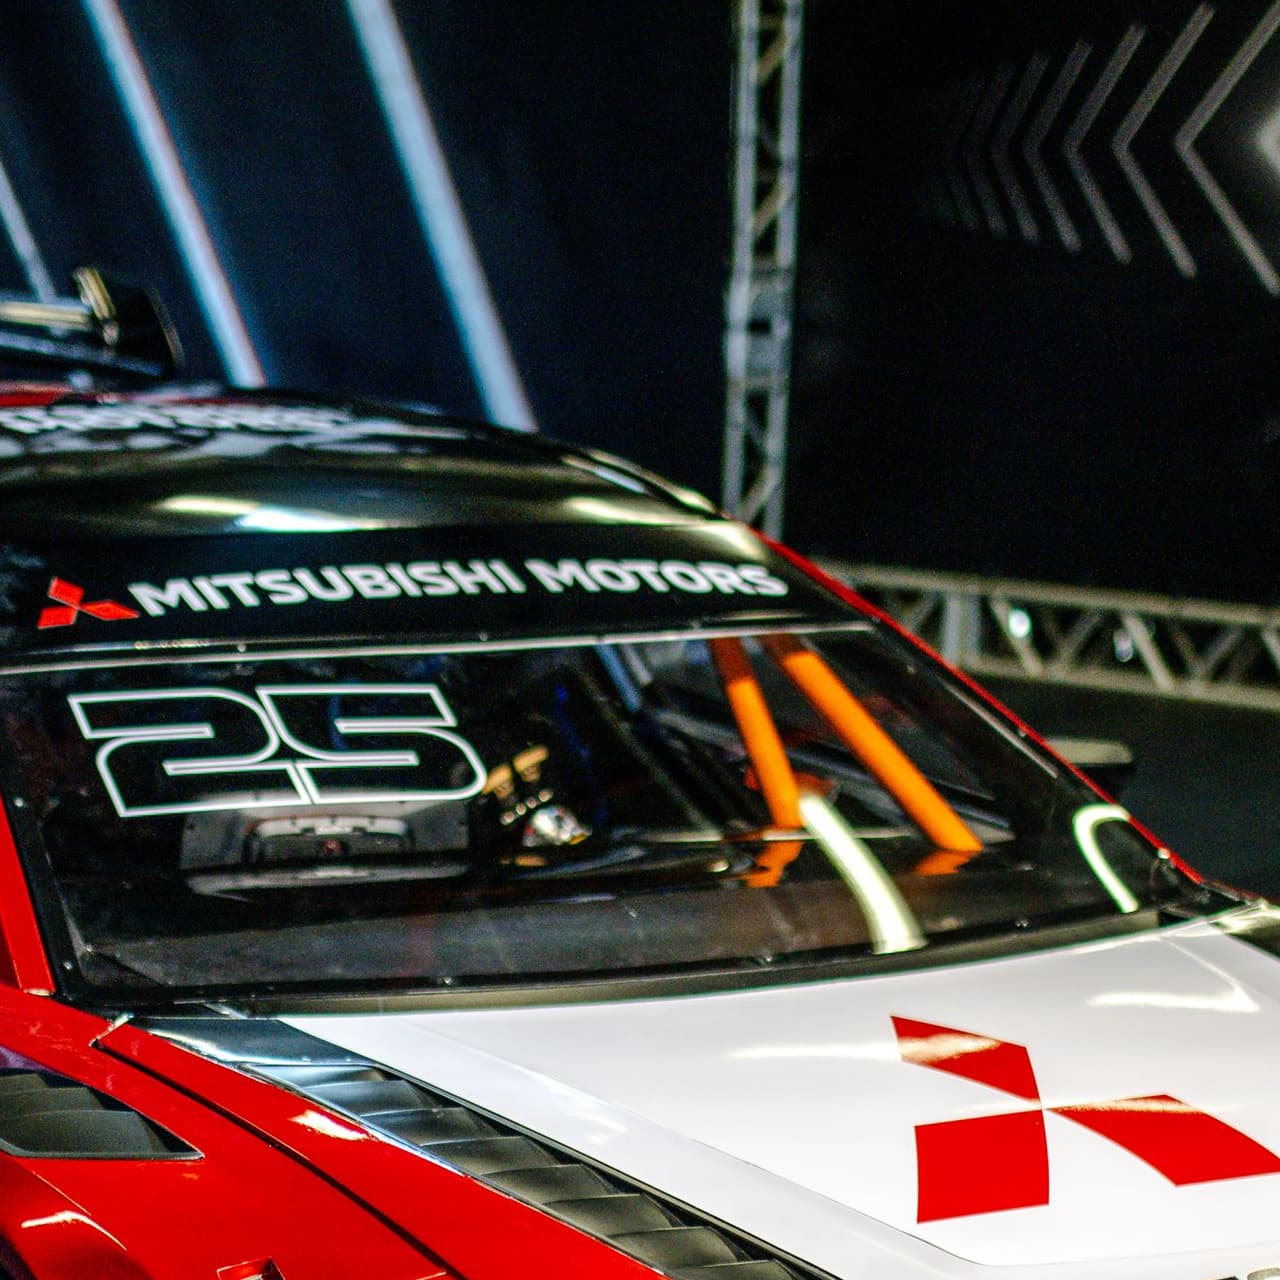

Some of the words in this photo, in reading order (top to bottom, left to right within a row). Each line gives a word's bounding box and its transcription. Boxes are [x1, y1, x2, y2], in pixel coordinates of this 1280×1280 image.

[128, 558, 525, 617] MITSUBISHI
[534, 559, 789, 599] MOTORS
[66, 683, 489, 819] 25
